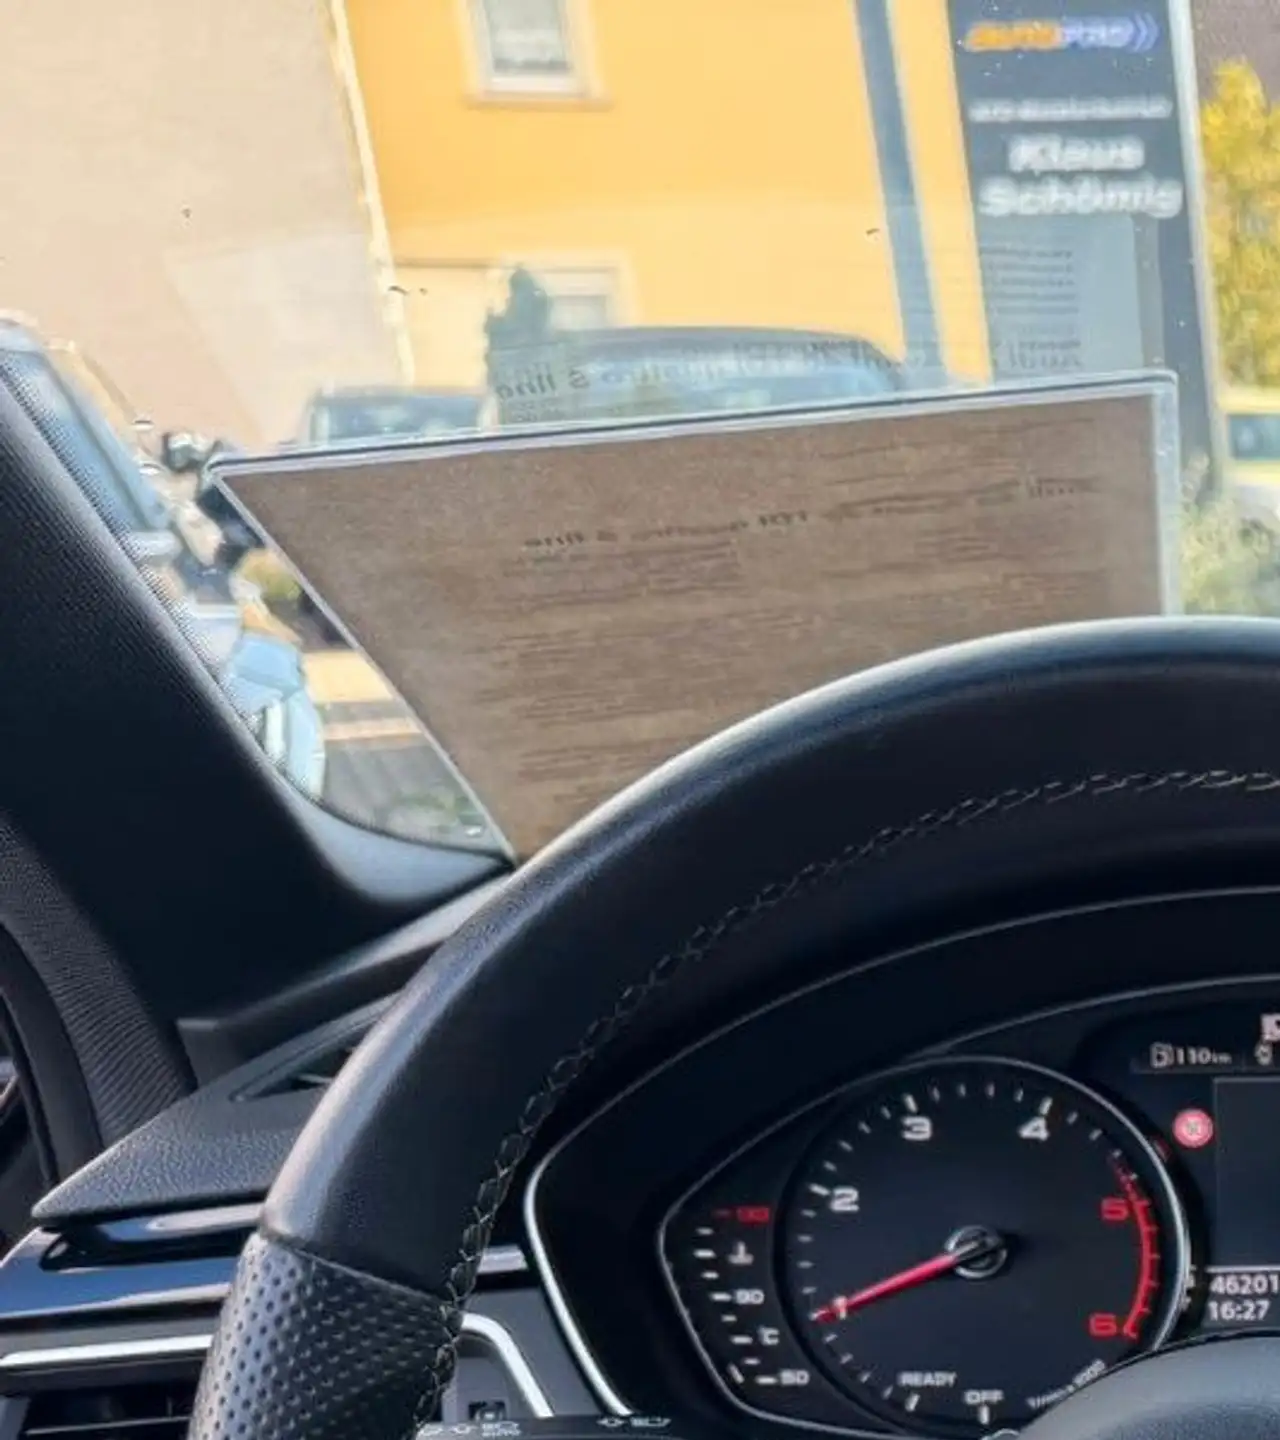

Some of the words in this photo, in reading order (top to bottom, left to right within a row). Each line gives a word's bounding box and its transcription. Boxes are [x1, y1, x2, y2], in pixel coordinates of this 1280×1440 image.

[1009, 135, 1145, 172] Klaus
[902, 1116, 933, 1141] 3
[1019, 1116, 1049, 1142] 4
[829, 1186, 860, 1213] 2
[1101, 1198, 1129, 1221] 5
[1208, 1300, 1270, 1321] 16:27
[1088, 1313, 1118, 1337] 6
[898, 1371, 957, 1387] READY
[964, 1389, 1004, 1405] OFF
